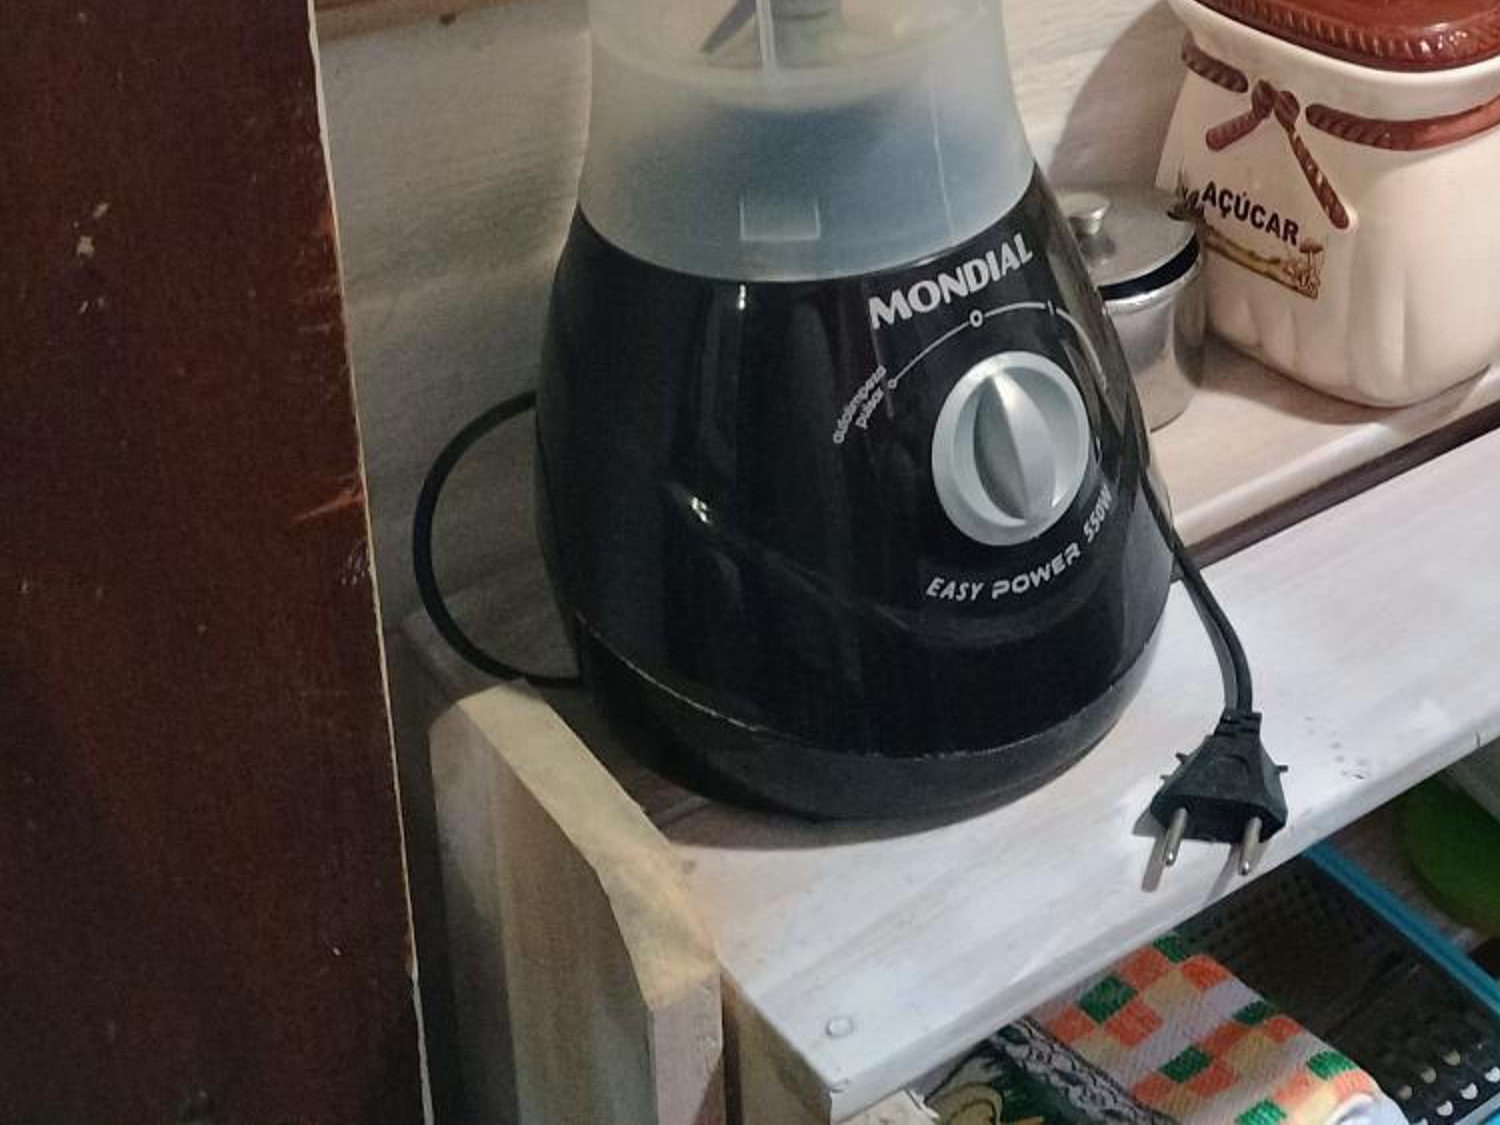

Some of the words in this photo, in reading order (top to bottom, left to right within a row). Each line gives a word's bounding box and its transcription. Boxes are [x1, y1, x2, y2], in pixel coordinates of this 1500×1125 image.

[1201, 180, 1299, 246] AÇÚCAR
[868, 233, 1034, 330] MONDIAL
[926, 577, 985, 603] EASY
[991, 541, 1082, 600] POWER
[1083, 482, 1113, 544] 550W
